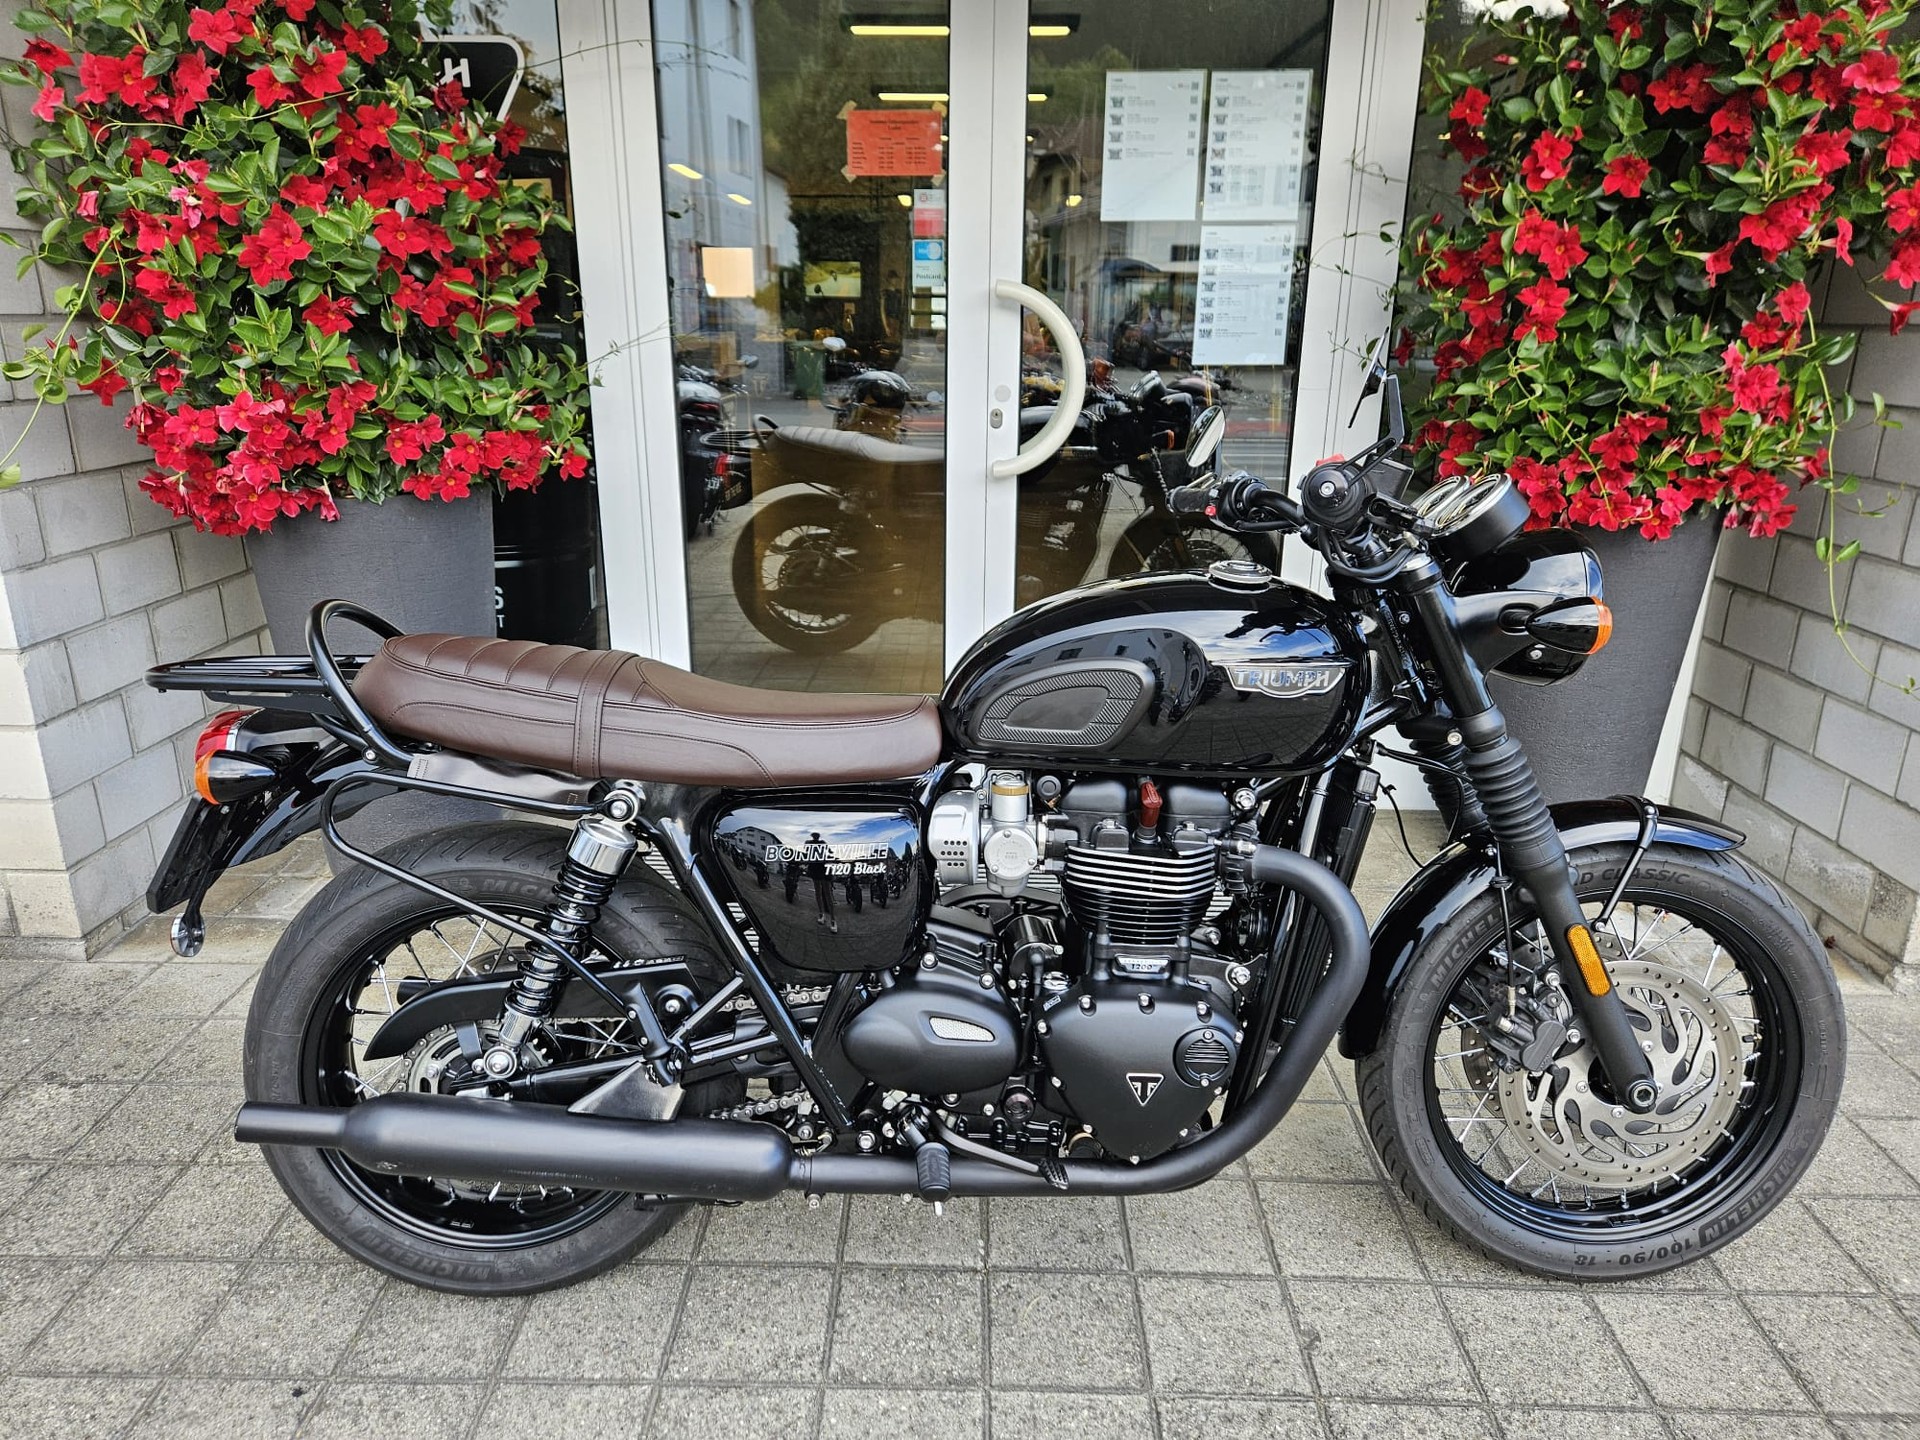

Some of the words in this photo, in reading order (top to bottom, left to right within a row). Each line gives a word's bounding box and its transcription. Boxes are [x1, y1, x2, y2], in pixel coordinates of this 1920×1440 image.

[1235, 669, 1330, 688] TRIUMPH
[765, 842, 889, 861] BONNEVILLE
[824, 863, 851, 876] T120
[853, 861, 887, 875] Black
[1704, 1154, 1798, 1242] MICHELIN
[361, 1230, 492, 1280] MICHELIN
[1574, 1254, 1596, 1266] 18
[1619, 1238, 1693, 1266] 100/90
